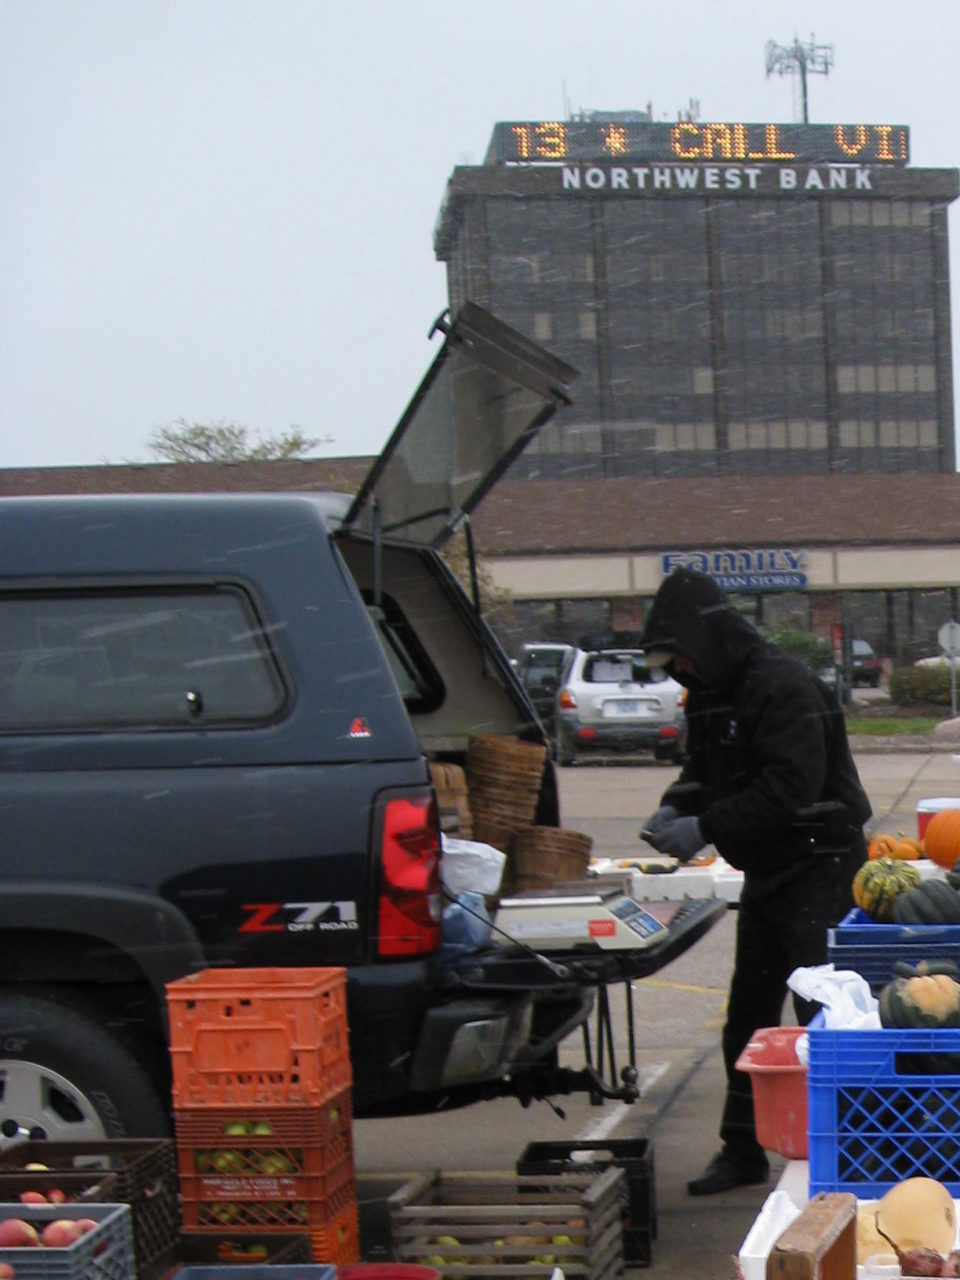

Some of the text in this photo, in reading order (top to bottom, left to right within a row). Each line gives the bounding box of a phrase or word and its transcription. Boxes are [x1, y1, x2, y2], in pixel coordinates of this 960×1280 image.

[671, 121, 796, 160] CALL
[834, 123, 906, 160] VI
[562, 167, 872, 190] NORTHWEST BANK
[750, 574, 800, 587] STORES
[238, 900, 358, 933] Z71
[287, 920, 359, 933] OFF ROAD
